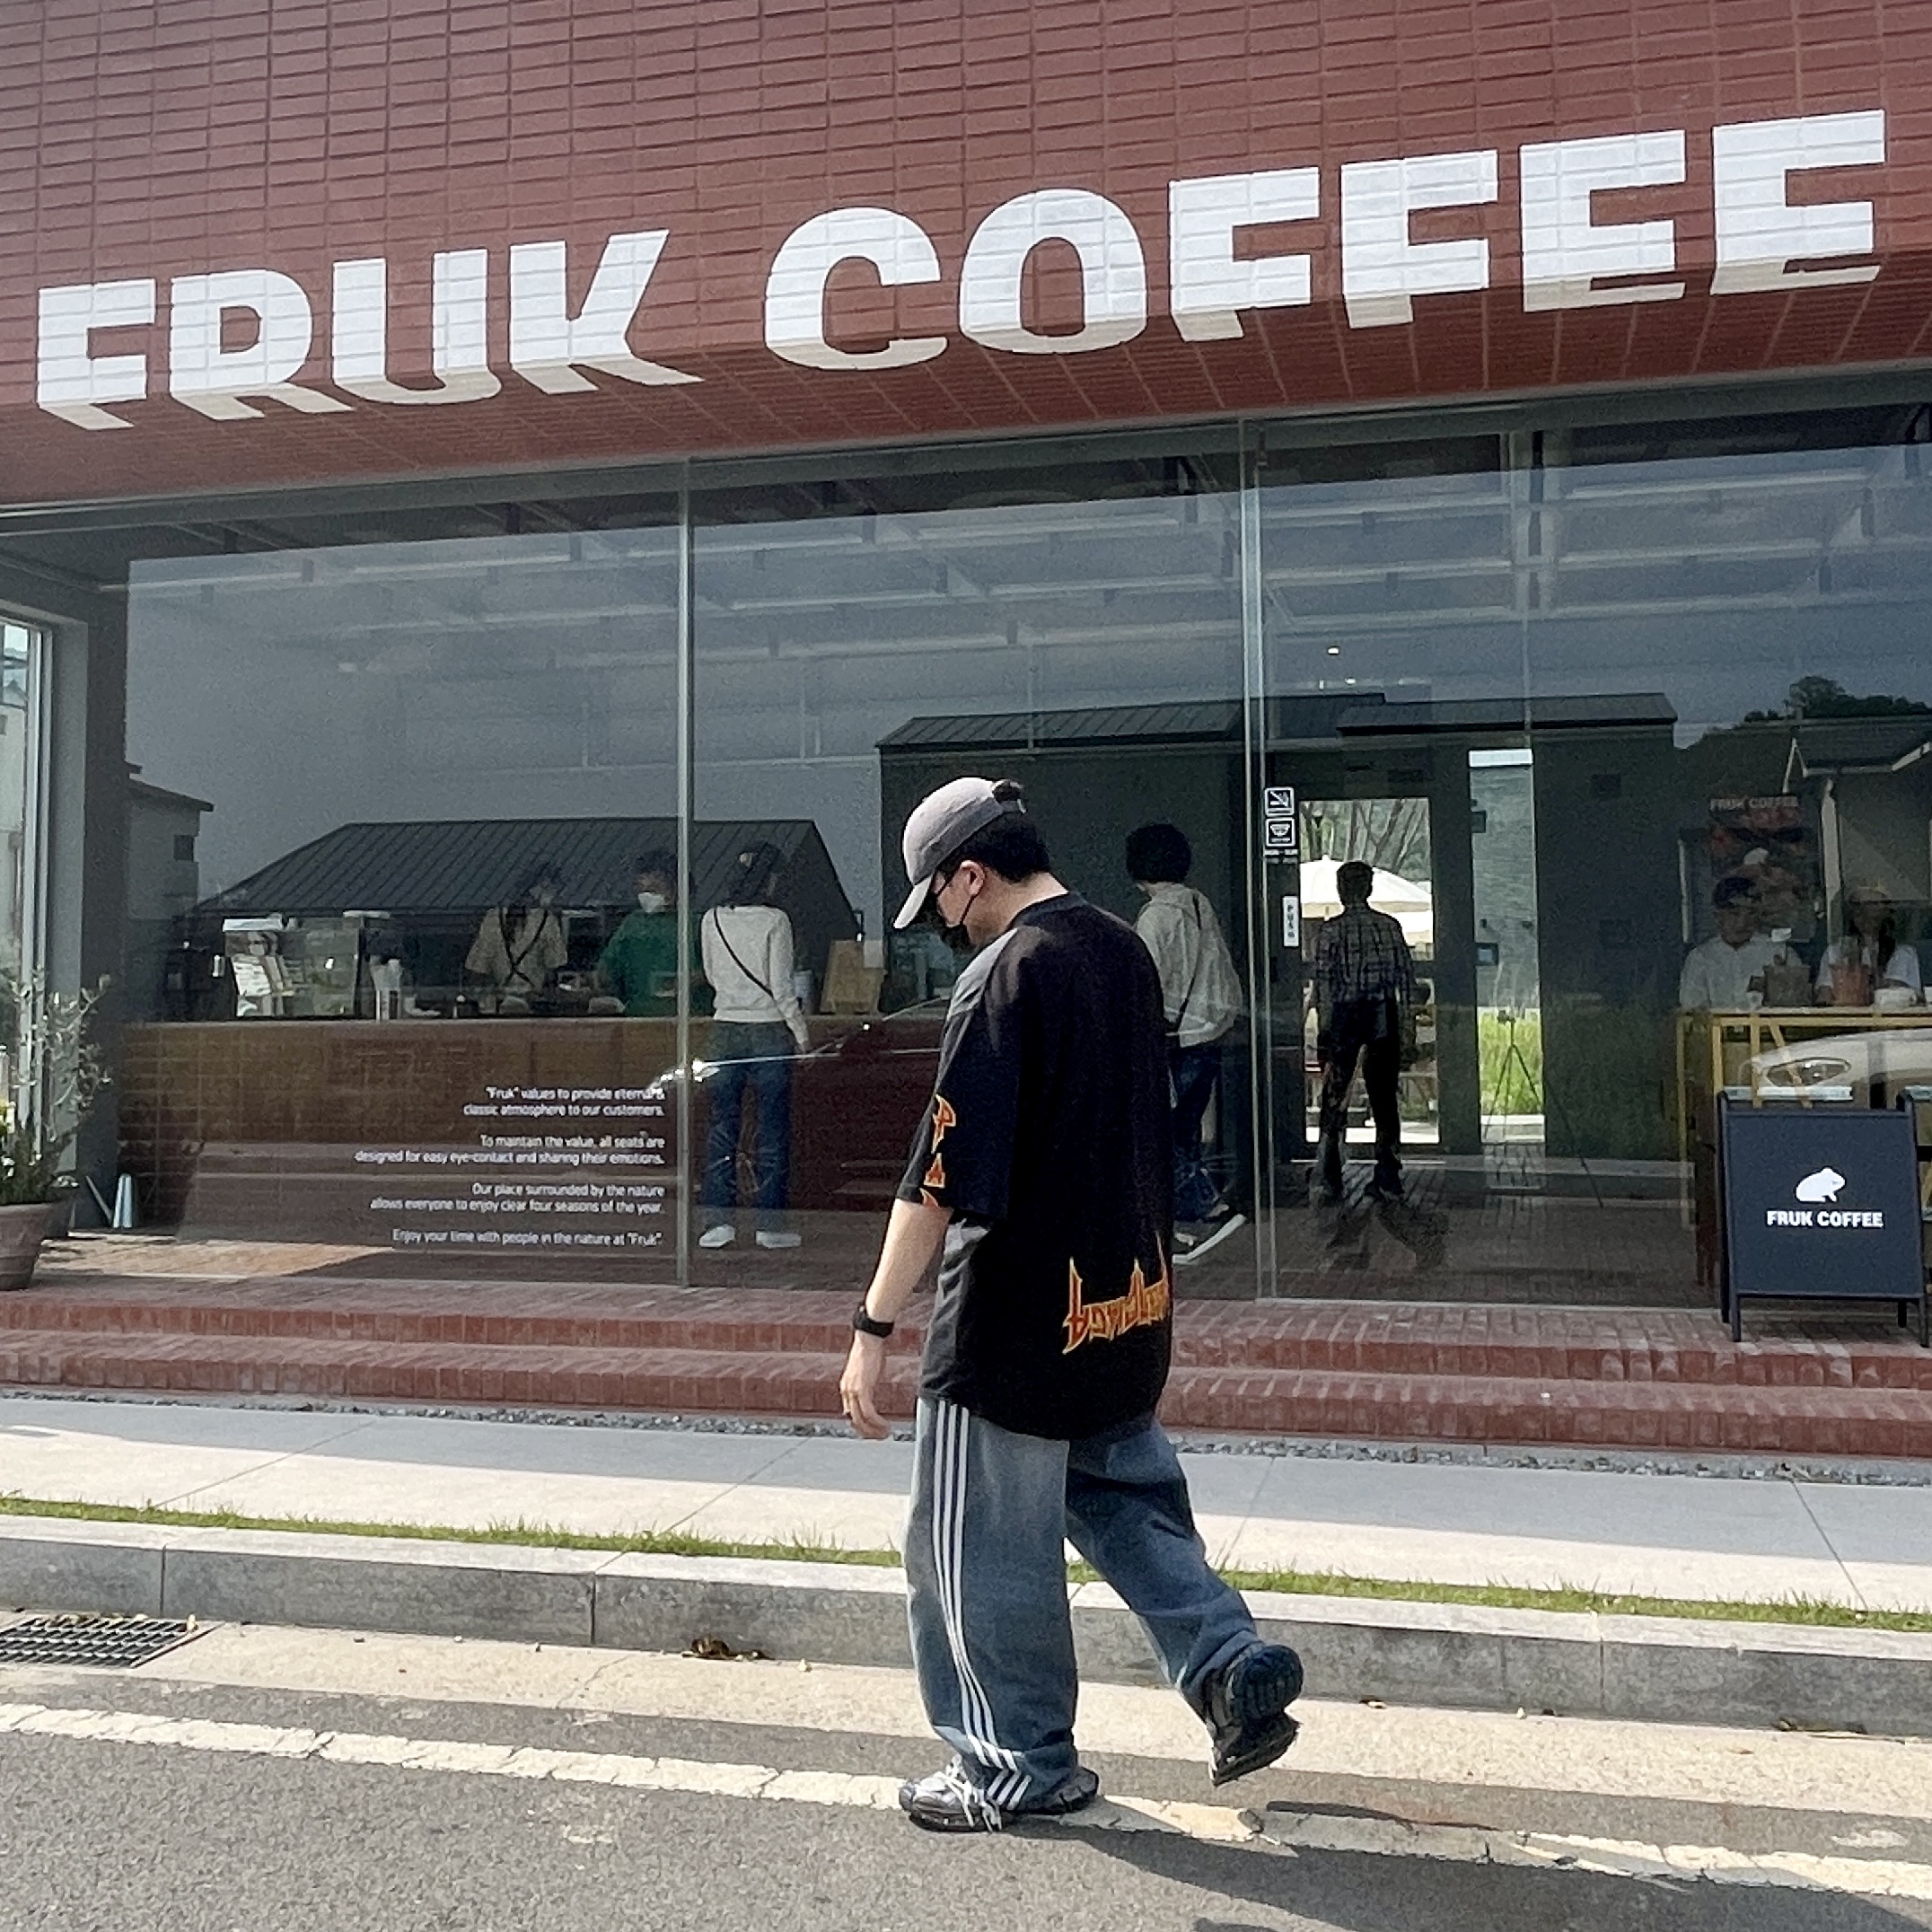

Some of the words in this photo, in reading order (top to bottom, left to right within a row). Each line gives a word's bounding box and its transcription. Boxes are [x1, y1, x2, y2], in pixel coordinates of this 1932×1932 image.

[38, 230, 702, 430] FRUK
[765, 110, 1885, 370] COFFEE
[521, 1088, 556, 1099] values
[557, 1088, 570, 1099] to
[571, 1088, 612, 1102] provide
[462, 1103, 499, 1116] classic
[500, 1104, 566, 1118] atmosphere
[568, 1104, 581, 1116] to
[582, 1105, 602, 1116] our
[479, 1135, 494, 1147] To
[495, 1137, 542, 1147] maintain
[544, 1137, 564, 1147] the
[599, 1136, 612, 1147] all
[614, 1137, 644, 1148] seats
[645, 1137, 665, 1148] are
[354, 1150, 404, 1164] designed
[405, 1150, 421, 1163] for
[423, 1153, 449, 1164] easy
[515, 1152, 537, 1164] and
[538, 1152, 580, 1166] sharing
[581, 1152, 609, 1164] their
[471, 1182, 493, 1195] Our
[495, 1184, 523, 1197] place
[525, 1184, 589, 1196] surrounded
[590, 1184, 605, 1199] by
[606, 1185, 627, 1196] the
[627, 1185, 665, 1197] nature
[404, 1200, 454, 1211] everyone
[455, 1199, 468, 1210] to
[469, 1200, 499, 1213] enjoy
[554, 1201, 600, 1212] seasons
[601, 1199, 615, 1212] of
[616, 1201, 637, 1212] the
[1766, 1209, 1813, 1227] FRUK
[1816, 1210, 1884, 1228] COFFEE
[392, 1228, 422, 1243] Enjoy
[423, 1232, 449, 1242] your
[450, 1231, 475, 1242] time
[476, 1231, 500, 1242] with
[502, 1232, 540, 1245] people
[540, 1234, 552, 1244] in
[553, 1232, 574, 1244] the
[574, 1234, 612, 1245] nature
[613, 1234, 626, 1245] at
